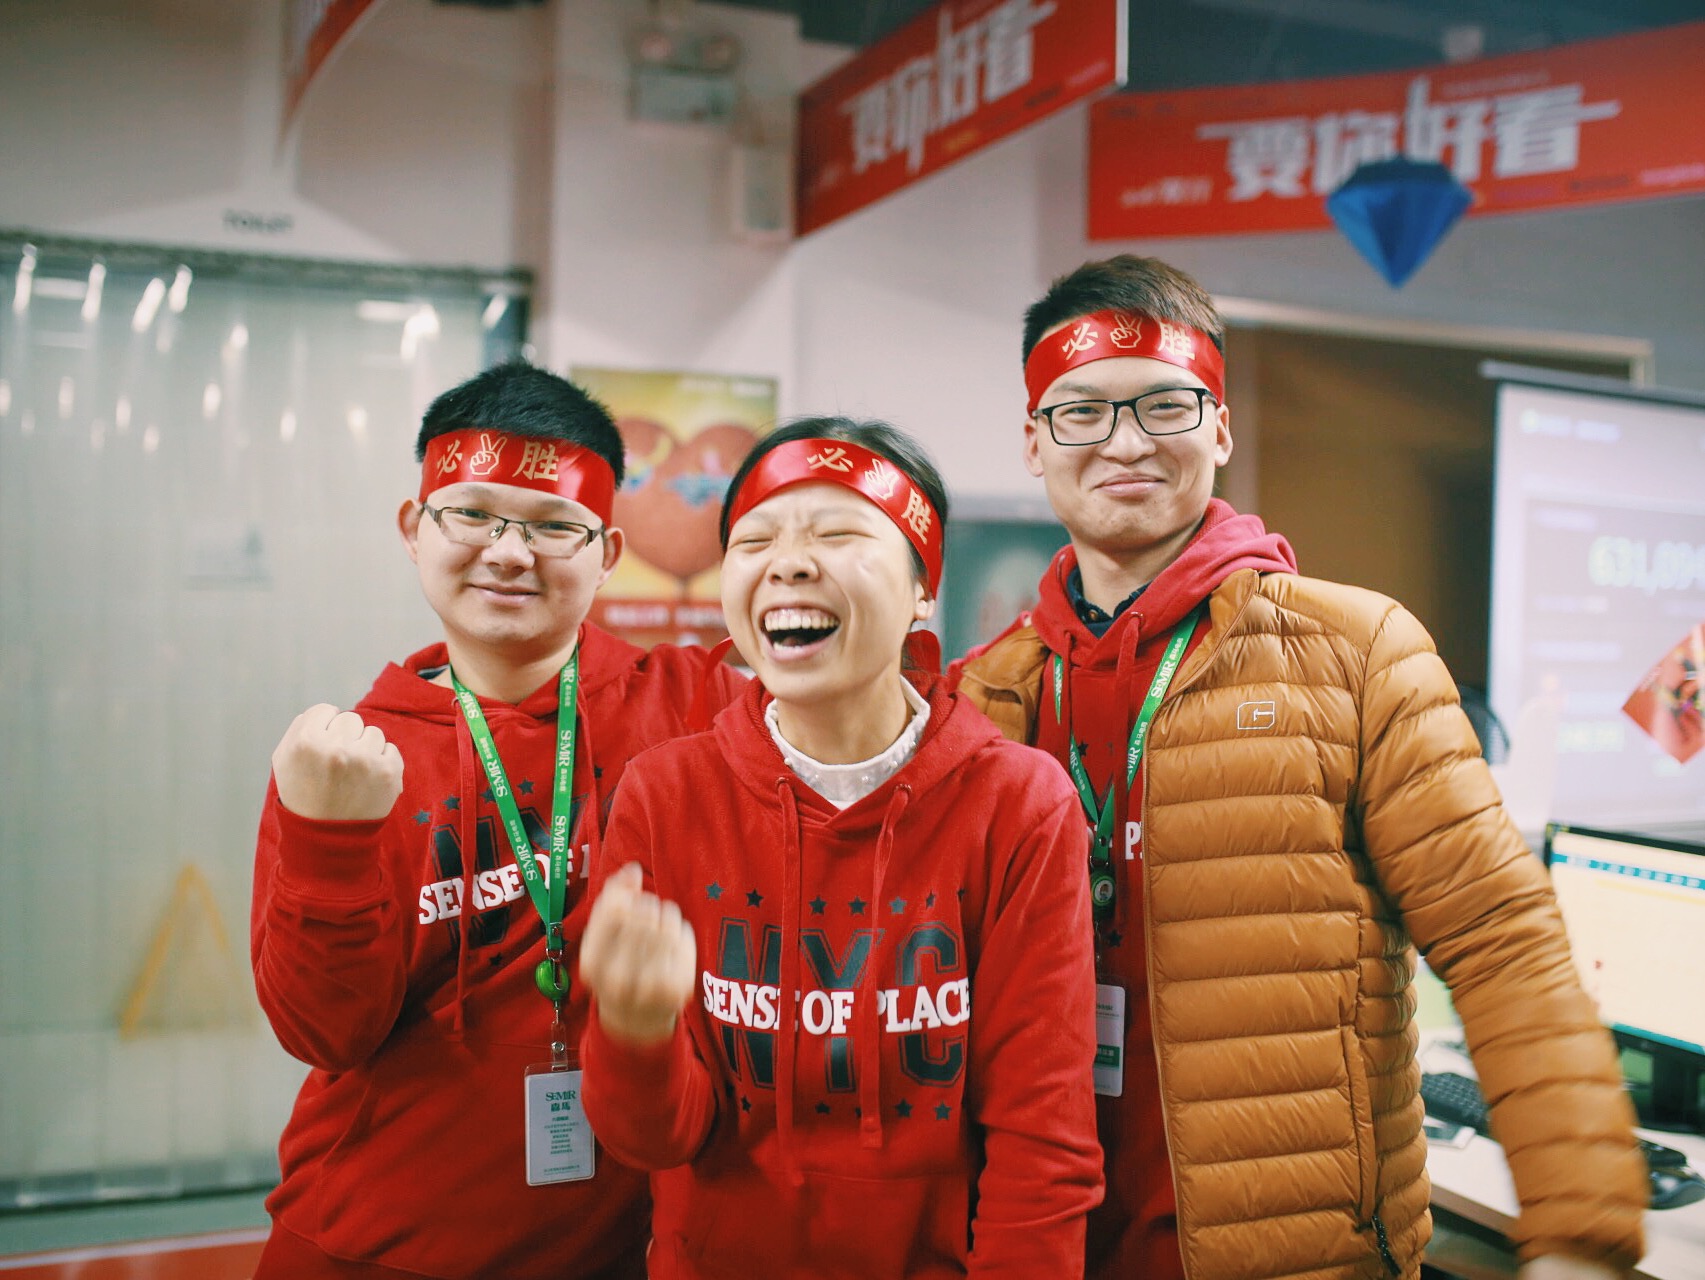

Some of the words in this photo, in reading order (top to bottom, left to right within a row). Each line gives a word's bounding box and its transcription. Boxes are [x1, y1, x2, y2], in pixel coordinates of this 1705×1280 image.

[1062, 323, 1098, 360] 必
[1158, 321, 1195, 360] 胜
[437, 439, 463, 476] 必
[512, 441, 560, 482] 胜
[806, 446, 854, 473] 必
[901, 487, 932, 545] 胜
[1150, 661, 1175, 699] SEMIR
[559, 730, 573, 767] SEMIR
[487, 759, 509, 798] SEMIR
[553, 815, 568, 853] SEMIR
[516, 843, 538, 881] SEMIR
[802, 989, 854, 1035] OF
[545, 1090, 576, 1101] SEMIR
